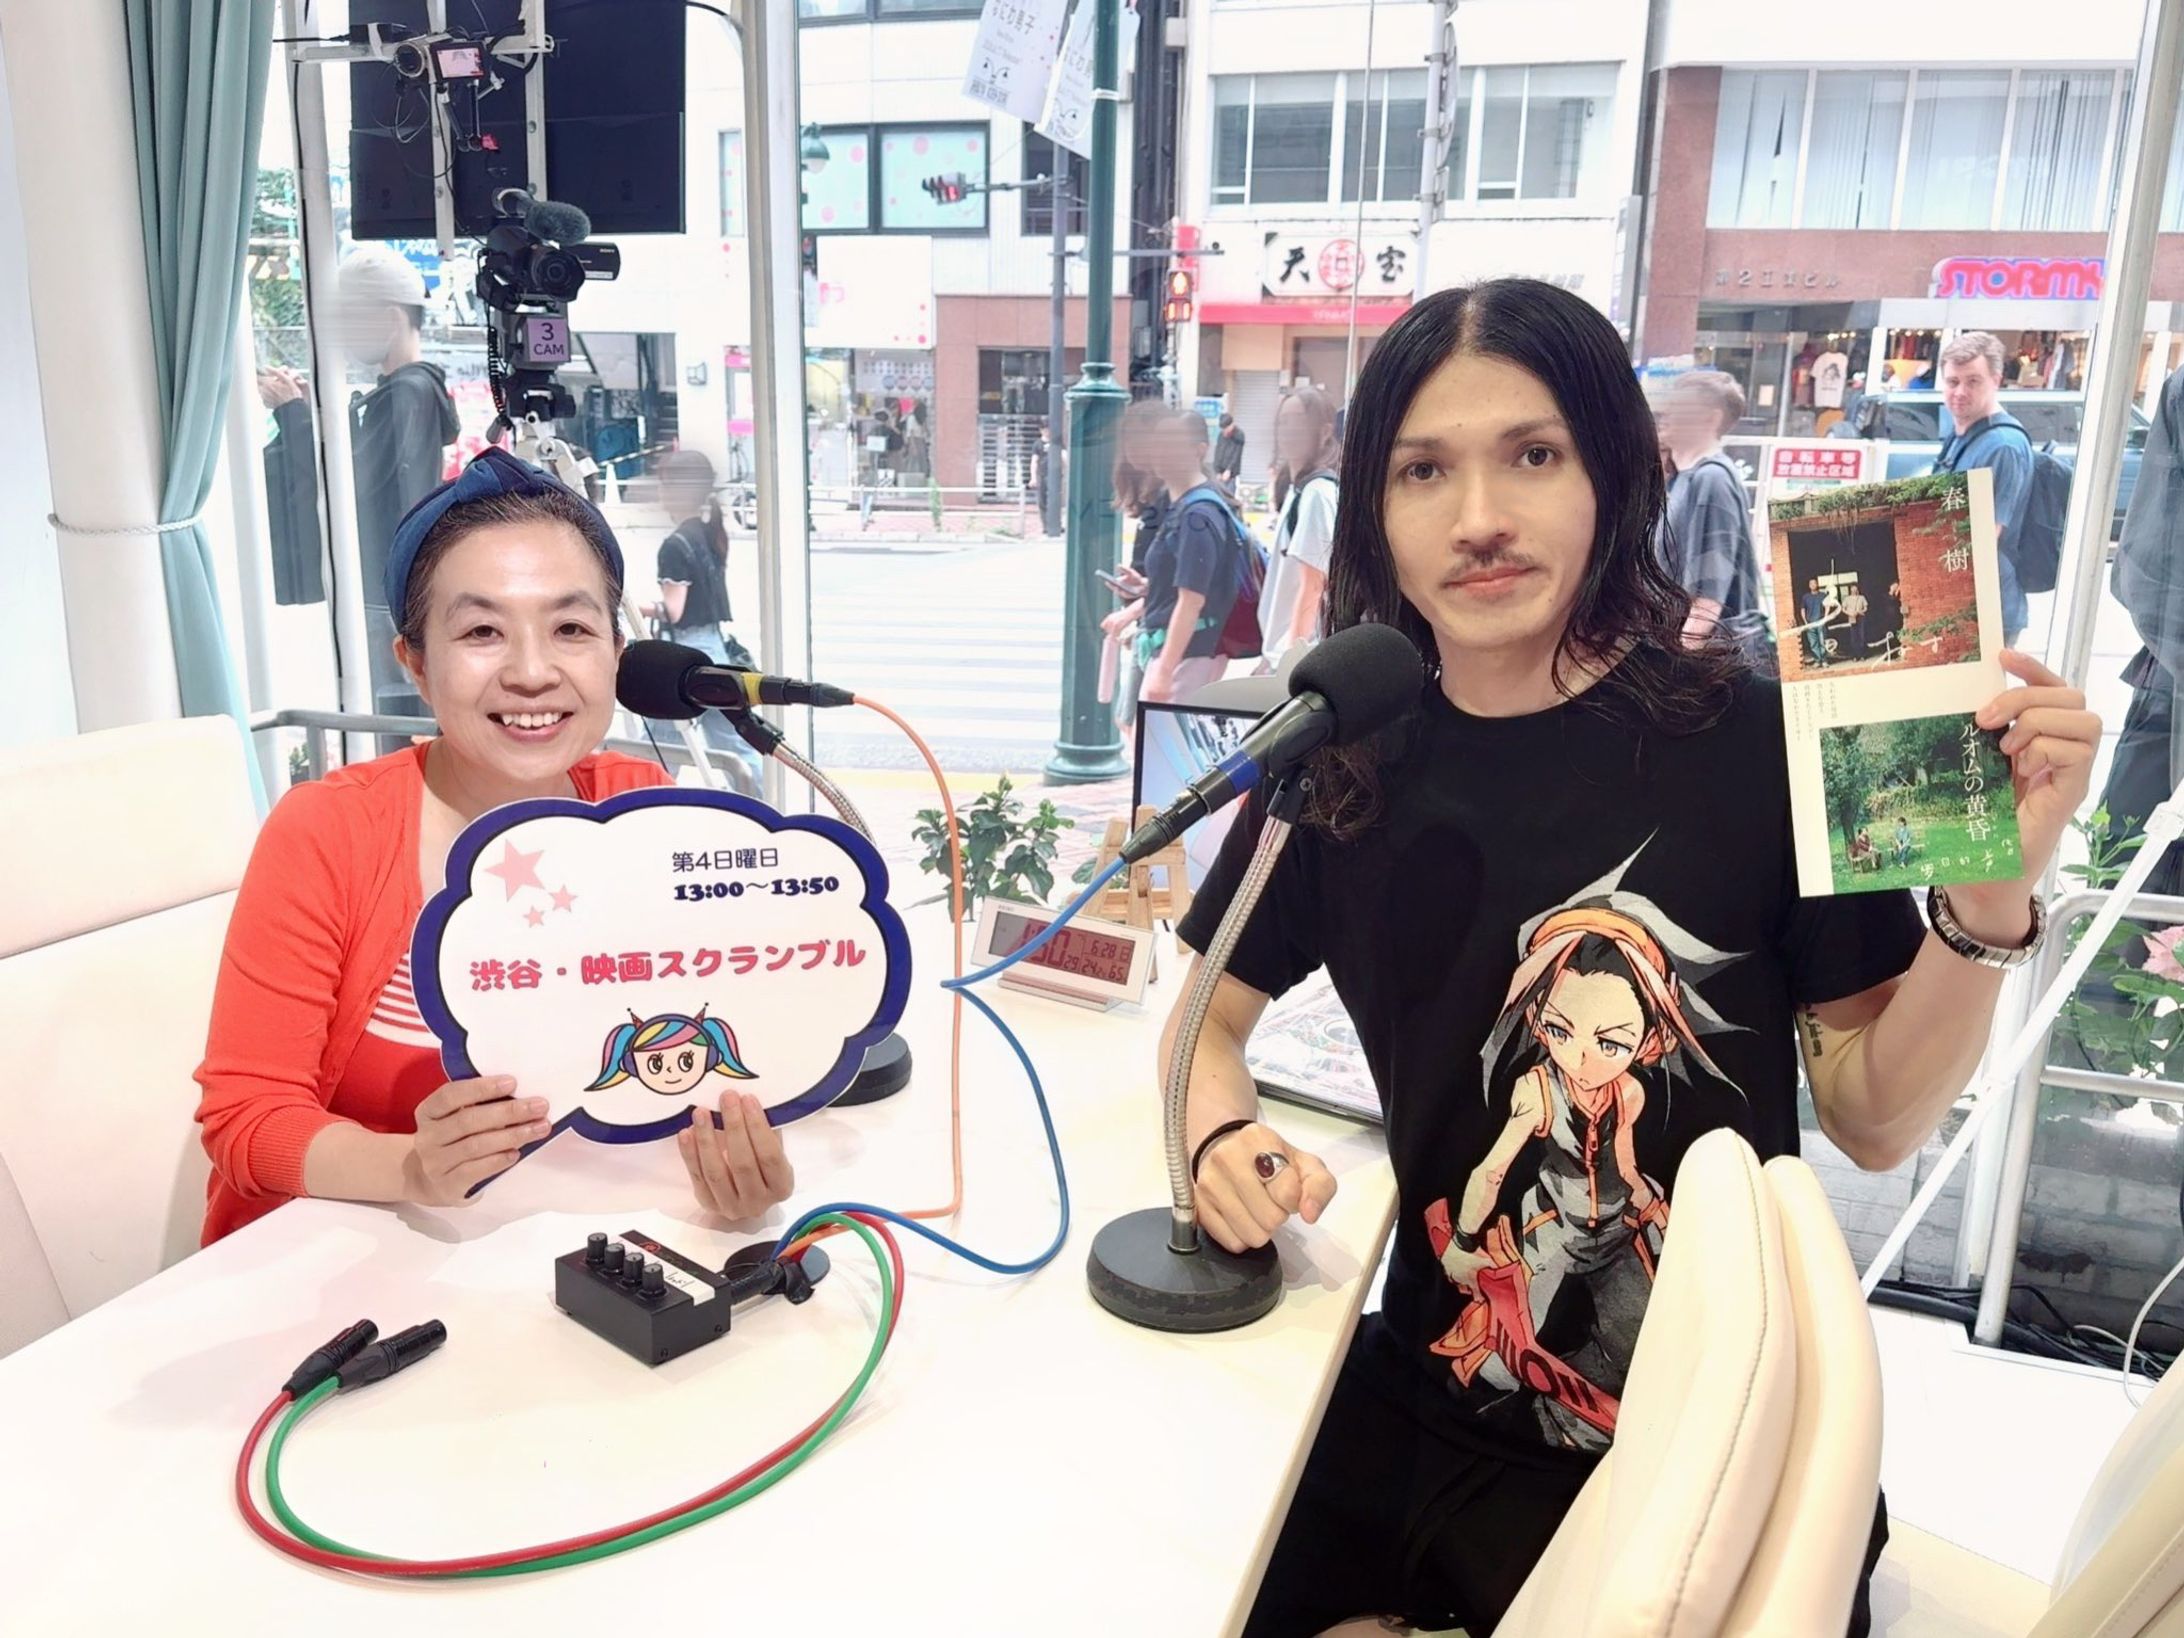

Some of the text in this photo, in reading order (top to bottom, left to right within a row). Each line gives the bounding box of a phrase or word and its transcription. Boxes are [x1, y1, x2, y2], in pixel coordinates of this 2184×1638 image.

[541, 322, 554, 341] 3
[533, 343, 564, 356] CAM
[670, 847, 780, 873] 第4日曜日
[469, 938, 867, 992] 渋谷・映画スクランブル
